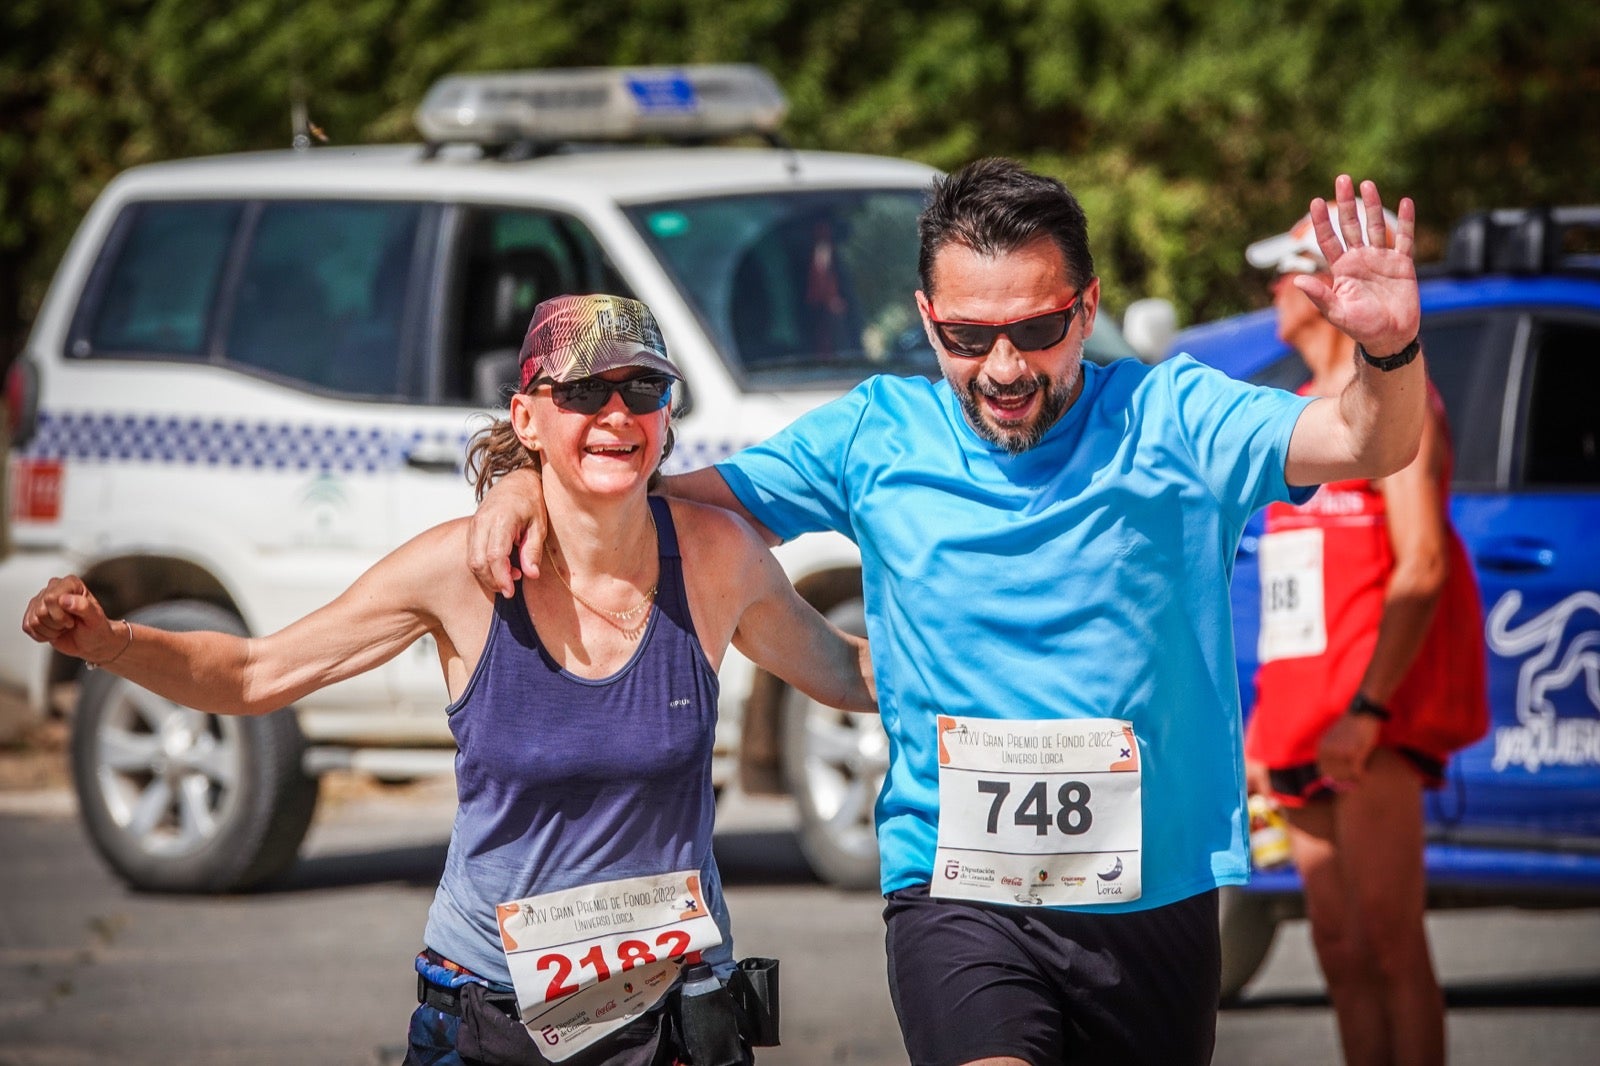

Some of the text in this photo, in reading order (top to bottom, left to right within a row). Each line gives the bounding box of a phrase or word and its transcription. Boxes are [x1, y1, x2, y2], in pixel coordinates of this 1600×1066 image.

[957, 731, 1113, 749] XXXV GRAN PREMIO DE FONDO 2022
[1002, 752, 1064, 764] UNIVERSO LORCA
[977, 780, 1093, 836] 748
[1096, 879, 1123, 896] Lorca
[523, 885, 676, 927] XXXV GRAN PREMIO DE FONDO 2022
[573, 912, 635, 932] UNIVERSO LORCA
[536, 930, 692, 1004] 2182
